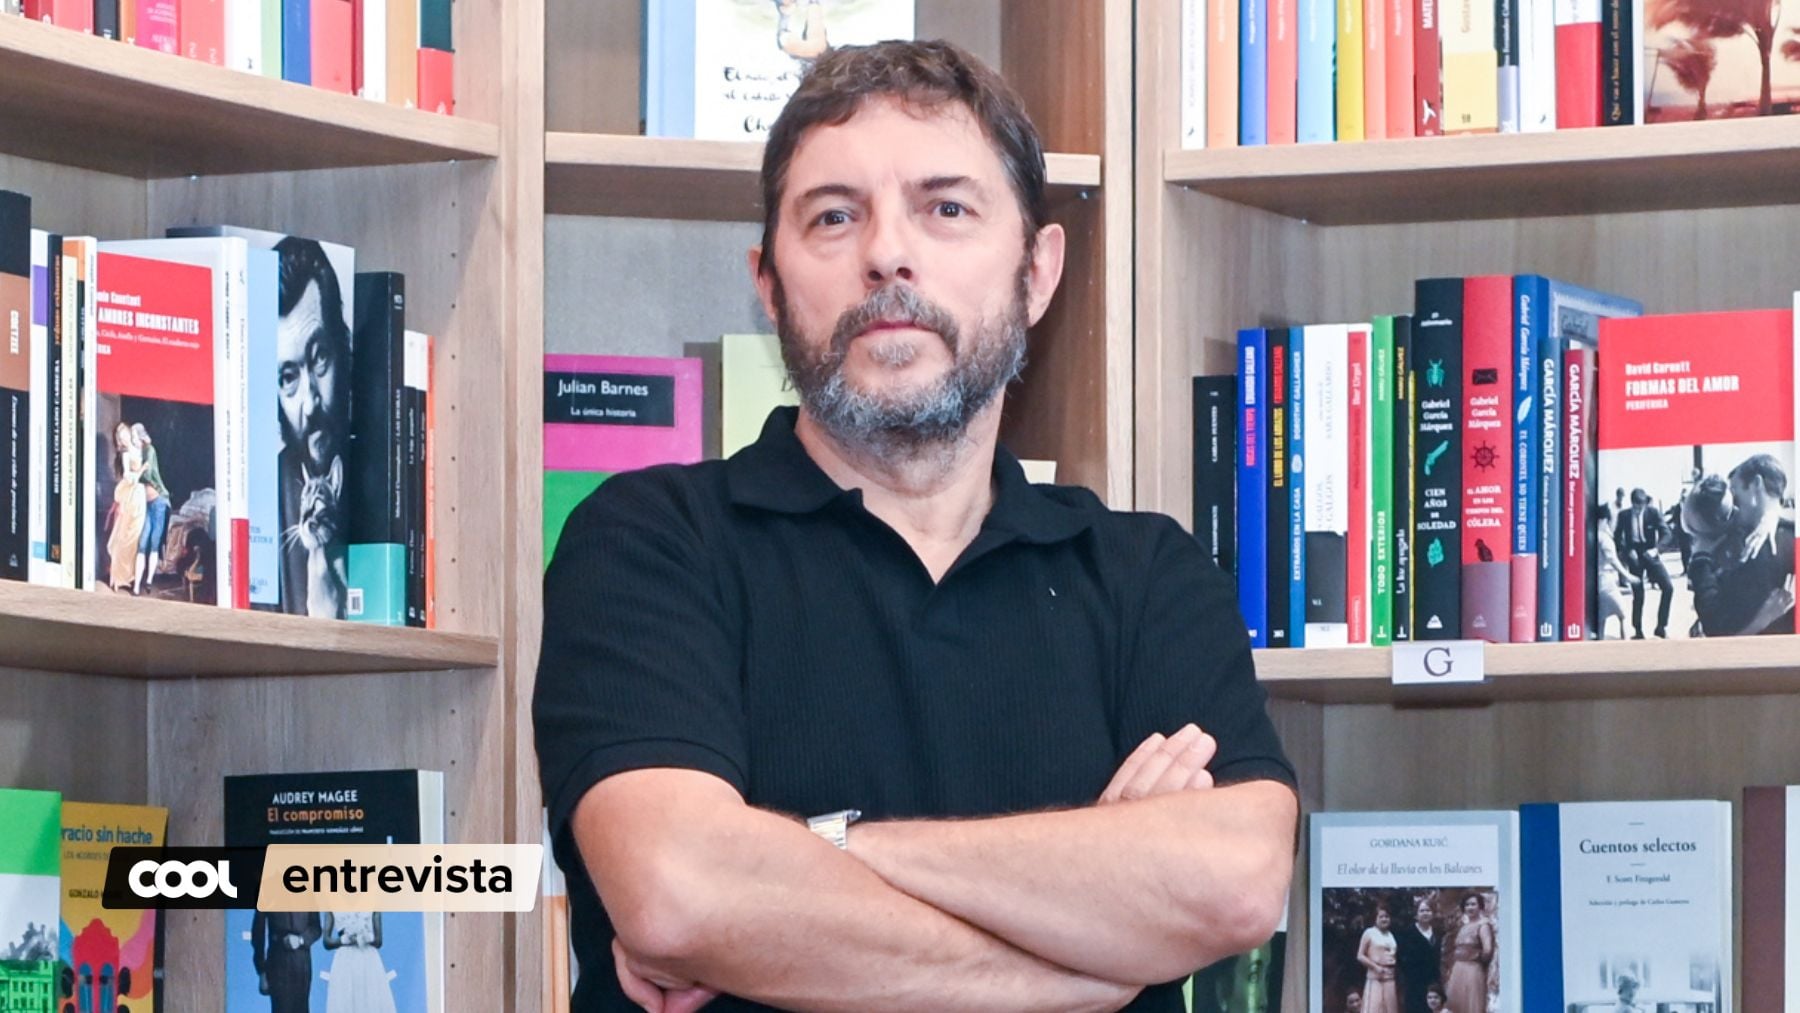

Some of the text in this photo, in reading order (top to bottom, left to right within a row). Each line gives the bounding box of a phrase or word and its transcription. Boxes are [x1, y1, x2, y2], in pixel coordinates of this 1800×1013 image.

[1518, 294, 1531, 392] Gabriel García Márquez
[1625, 360, 1691, 376] David Garnett
[557, 380, 649, 397] Julian Barnes
[1625, 375, 1740, 397] FORMAS DEL AMOR
[1293, 351, 1301, 440] DOROTHY GALLAGHER
[1469, 396, 1499, 406] Gabriel
[1421, 399, 1450, 409] Gabriel
[570, 407, 637, 418] La única historia
[1423, 411, 1448, 420] García
[1471, 408, 1497, 418] García
[1543, 358, 1557, 474] GARCÍA MÁRQUEZ
[1420, 422, 1453, 433] Márquez
[1468, 420, 1501, 431] Márquez
[1569, 363, 1583, 480] GARCÍA MÁRQUEZ
[1519, 430, 1527, 440] EL
[1424, 488, 1447, 498] CIEN
[1475, 485, 1502, 495] AMOR
[1518, 482, 1527, 496] NO
[1293, 487, 1301, 511] CASA
[1424, 498, 1448, 509] AÑOS
[1518, 496, 1527, 522] TIENE
[1293, 522, 1301, 536] EN
[1416, 520, 1457, 531] SOLEDAD
[1466, 516, 1502, 528] CÓLERA
[1292, 536, 1301, 581] EXTRAÑOS
[1377, 510, 1386, 596] TODO EXTERIOR
[1423, 647, 1454, 677] G
[272, 789, 358, 805] AUDREY MAGEE
[267, 806, 364, 825] El compromiso
[61, 824, 153, 844] racio sin hache
[1369, 838, 1421, 848] GORDANA
[1579, 837, 1697, 855] Cuentos selectos
[1337, 861, 1483, 875] El olor de la lluvia en los Balcanes
[1614, 873, 1671, 885] Scott Fitzgerald
[68, 889, 99, 899] GONZALO
